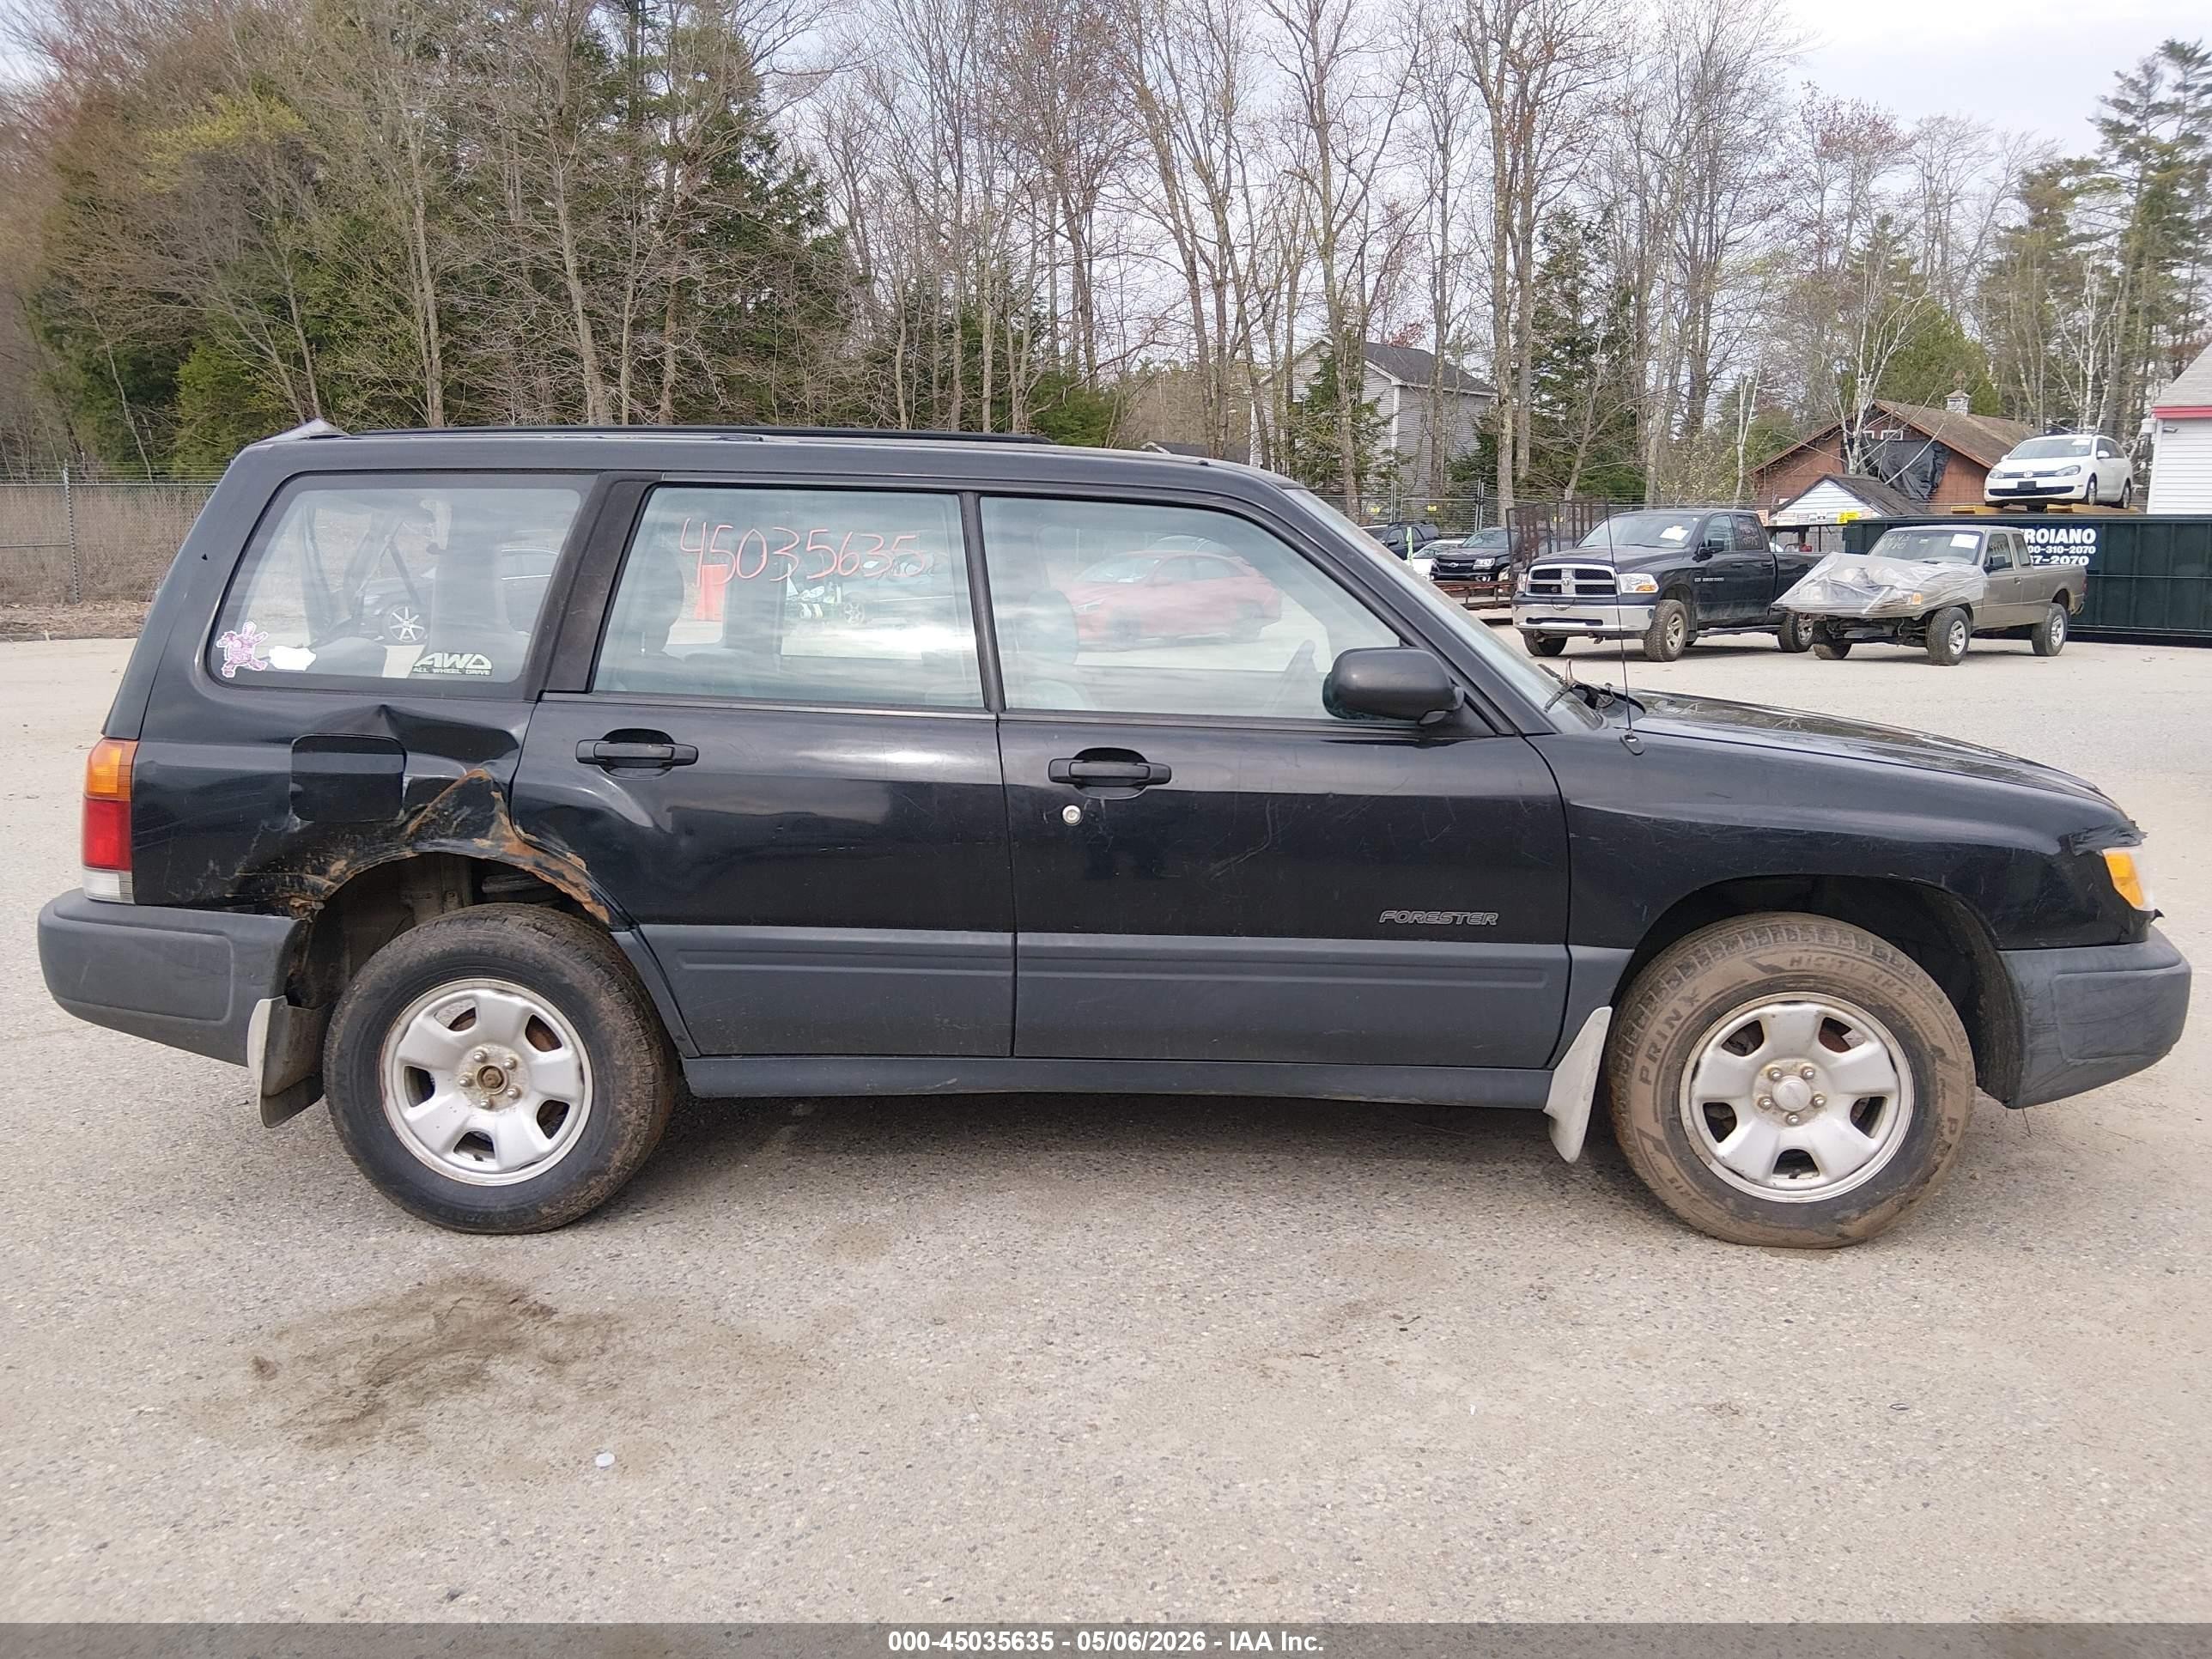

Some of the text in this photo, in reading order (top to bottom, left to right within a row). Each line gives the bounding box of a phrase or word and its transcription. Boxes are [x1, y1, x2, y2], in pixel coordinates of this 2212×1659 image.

[680, 517, 927, 587] 45035635
[414, 653, 492, 669] AWD
[1379, 910, 1498, 926] FORESTER
[1638, 986, 1700, 1086] PRINX
